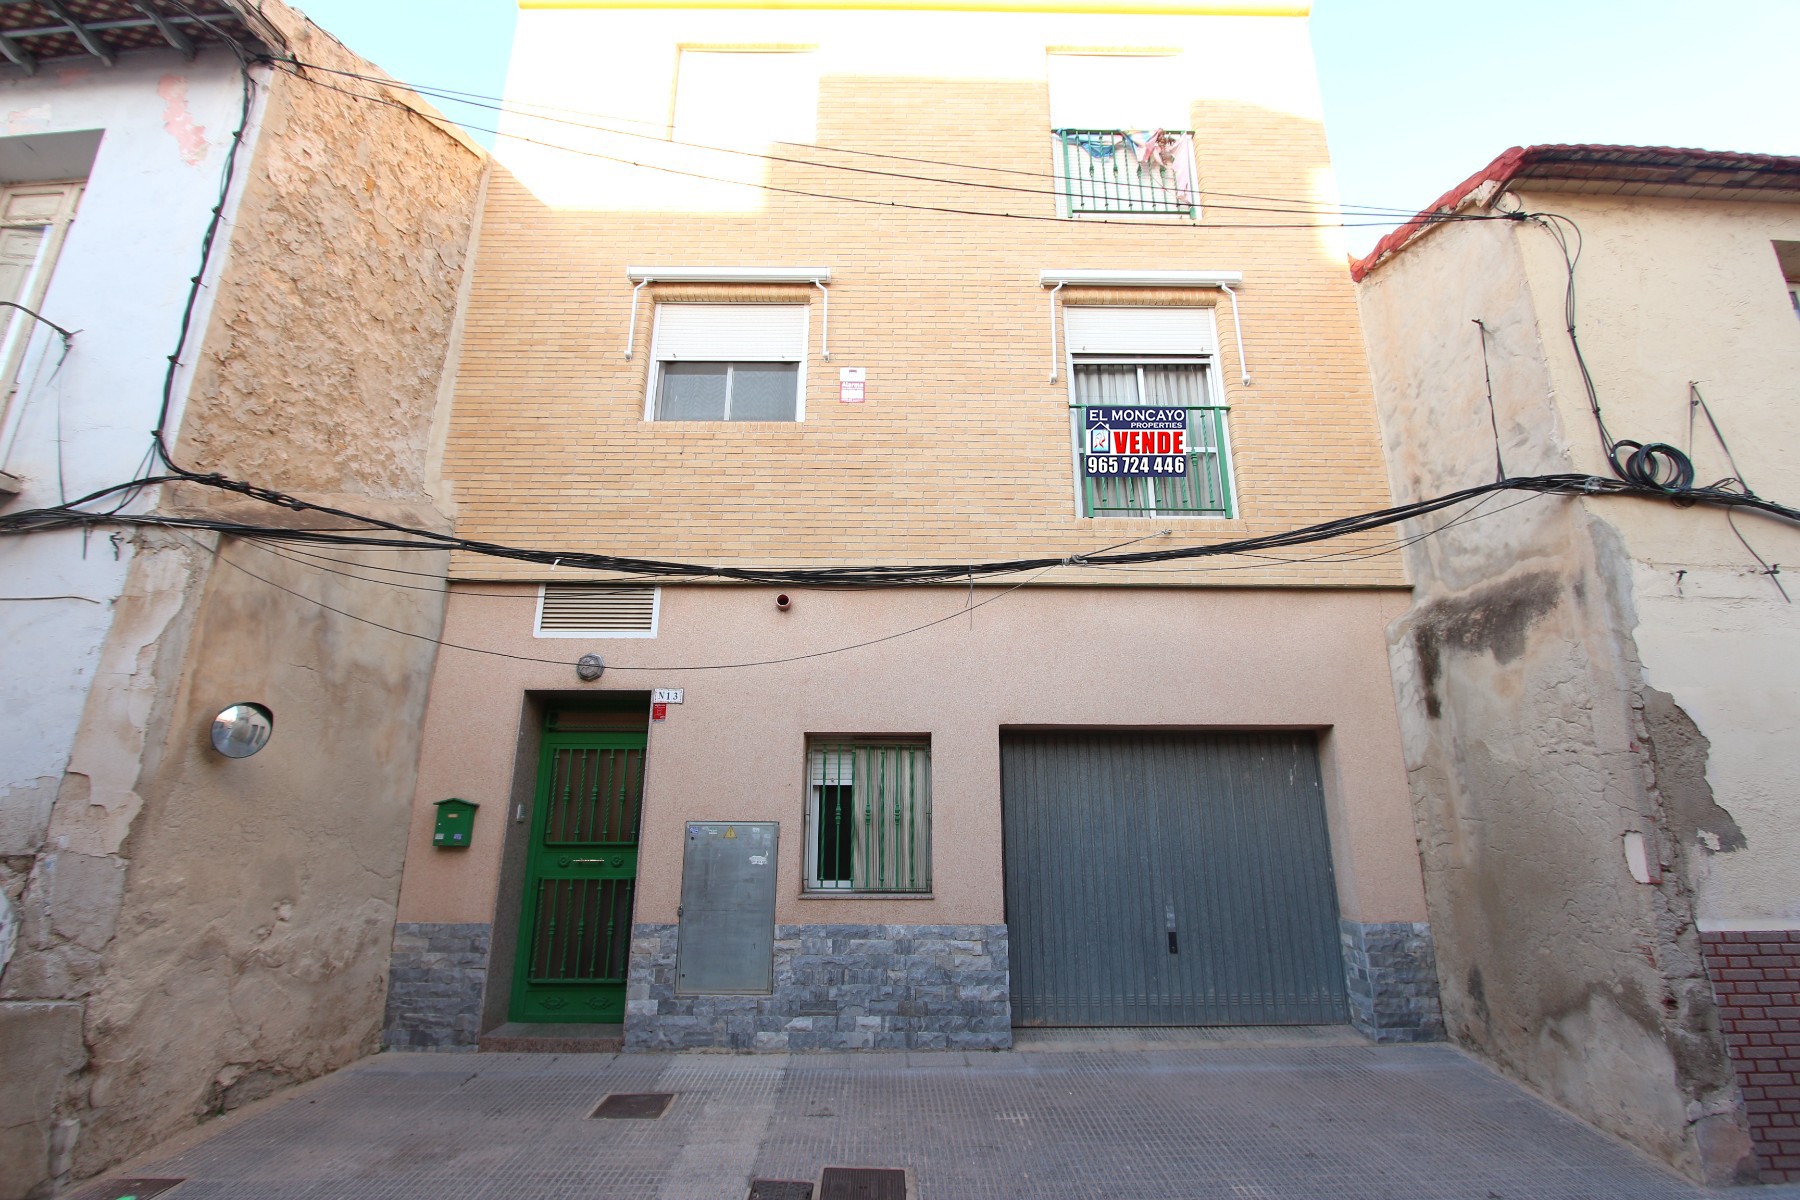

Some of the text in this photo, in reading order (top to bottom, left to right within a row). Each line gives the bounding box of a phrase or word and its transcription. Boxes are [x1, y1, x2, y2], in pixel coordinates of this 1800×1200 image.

[1089, 409, 1185, 421] EL MONCAYO
[1113, 431, 1184, 454] VENDE
[1087, 456, 1185, 474] 965 724 446
